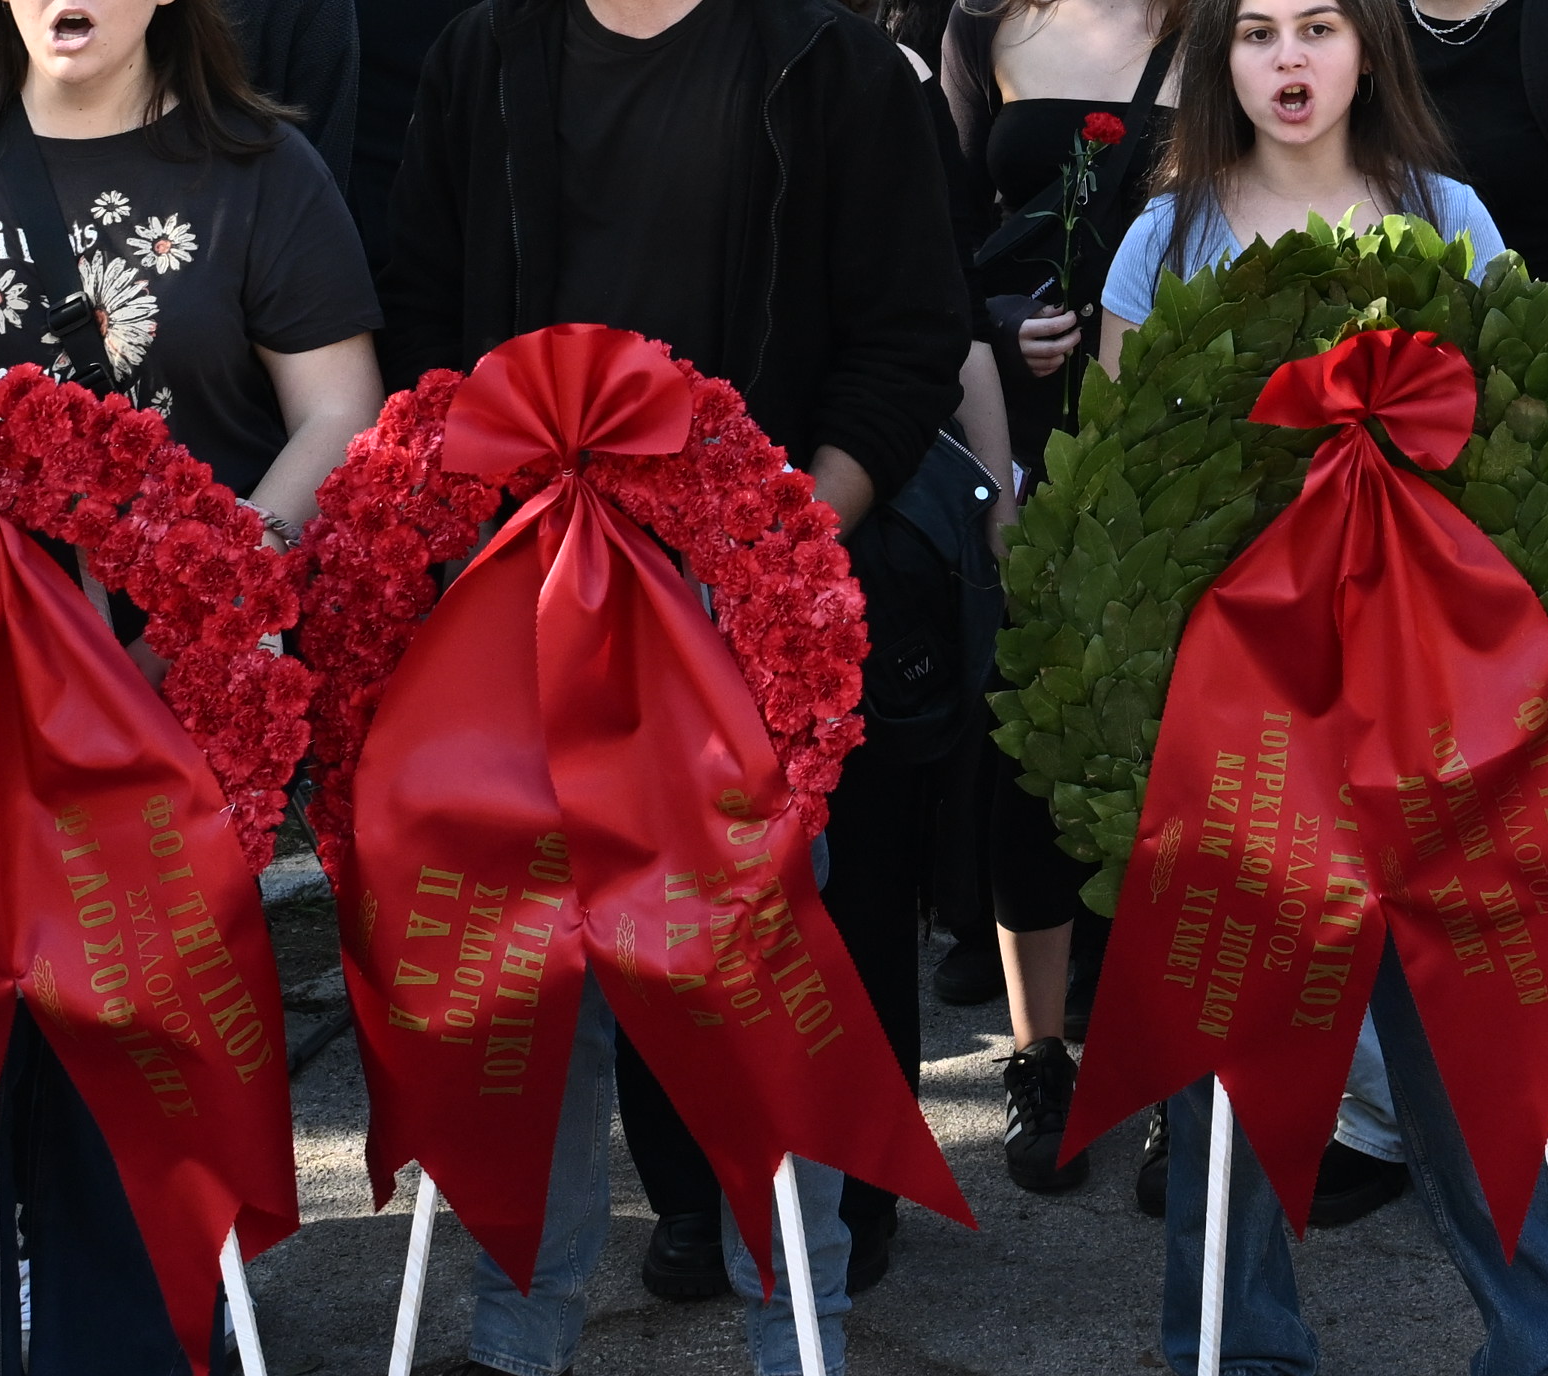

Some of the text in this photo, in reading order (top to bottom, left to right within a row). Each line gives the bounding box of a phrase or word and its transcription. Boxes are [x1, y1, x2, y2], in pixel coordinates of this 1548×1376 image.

[1163, 751, 1247, 991] ΝΑΖΙΜ ΧΙΧΜΕΤ
[1196, 710, 1291, 1041] ΤΟΥΡΚΙΚΩΝ ΣΠΟΥΔΩΝ
[1262, 811, 1321, 973] ΣΥΛΛΟΓΟΣ
[1394, 773, 1496, 979] ΝΑΖΙΜ ΧΙΧΜΕΤ
[1426, 719, 1497, 863] ΤΟΥΡΚΙΚΩΝ
[54, 804, 199, 1119] ΦΙΛΟΣΟΦΙΚΗΣ
[125, 885, 202, 1050] ΣΥΛΛΟΓΟΣ
[140, 794, 273, 1085] ΦΟΙΤΗΤΙΚΟΣ
[439, 882, 508, 1046] ΣΥΛΛΟΓΟΙ
[478, 832, 571, 1097] ΦΟΙΤΗΤΙΚΟΙ
[702, 867, 772, 1028] ΣΥΛΛΟΓΟΙ
[714, 788, 844, 1060] ΦΟΙΤΗΤΙΚΟΙ
